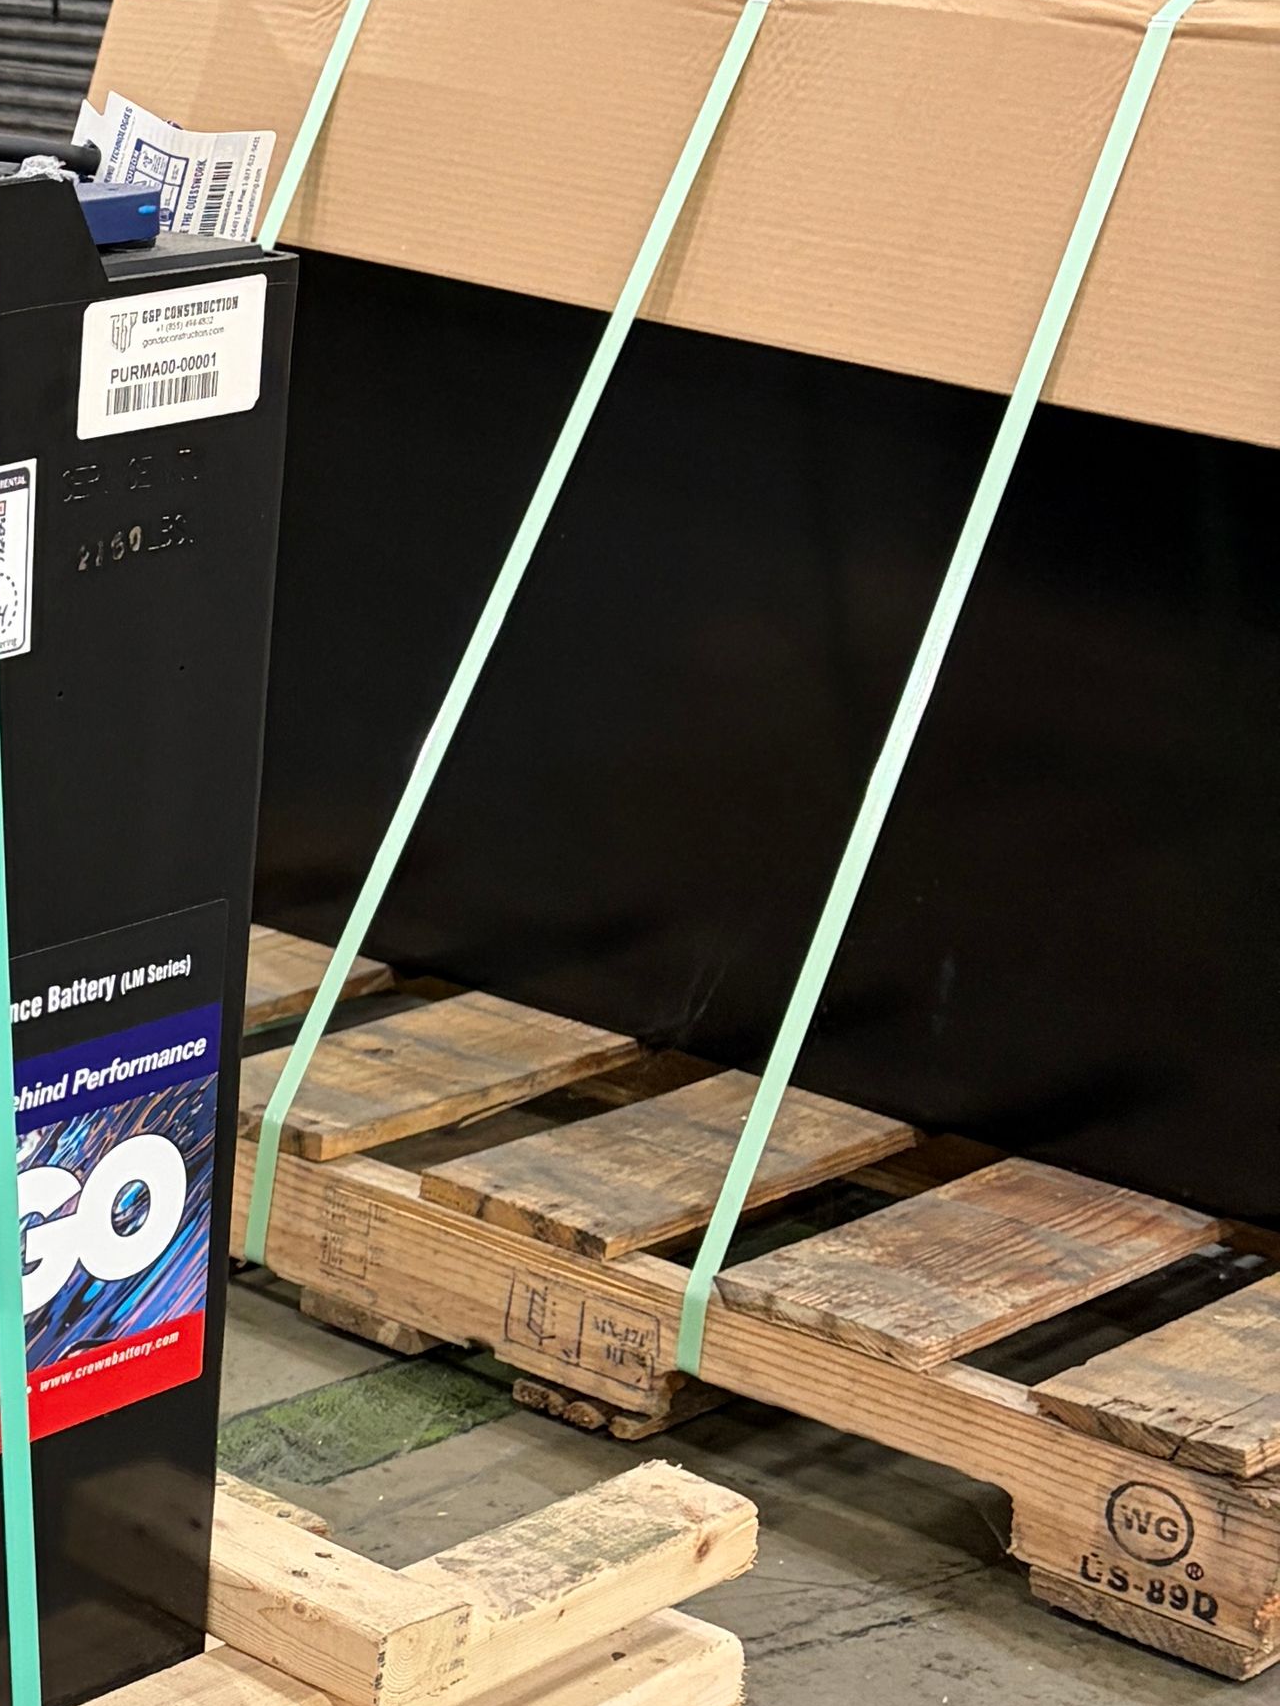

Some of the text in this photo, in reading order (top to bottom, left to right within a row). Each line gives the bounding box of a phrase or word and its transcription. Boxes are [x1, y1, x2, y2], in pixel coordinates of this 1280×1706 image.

[164, 296, 239, 321] CONSTRUCTION
[110, 352, 217, 384] PURMA00-00001
[0, 475, 26, 490] RENTAL
[47, 973, 116, 1015] Battery
[121, 971, 145, 995] (LM
[147, 954, 192, 985] Series)
[11, 1073, 69, 1113] ehind
[72, 1036, 208, 1095] Performance
[39, 1331, 180, 1393] www.crownbattery.com
[1120, 1504, 1185, 1543] WG
